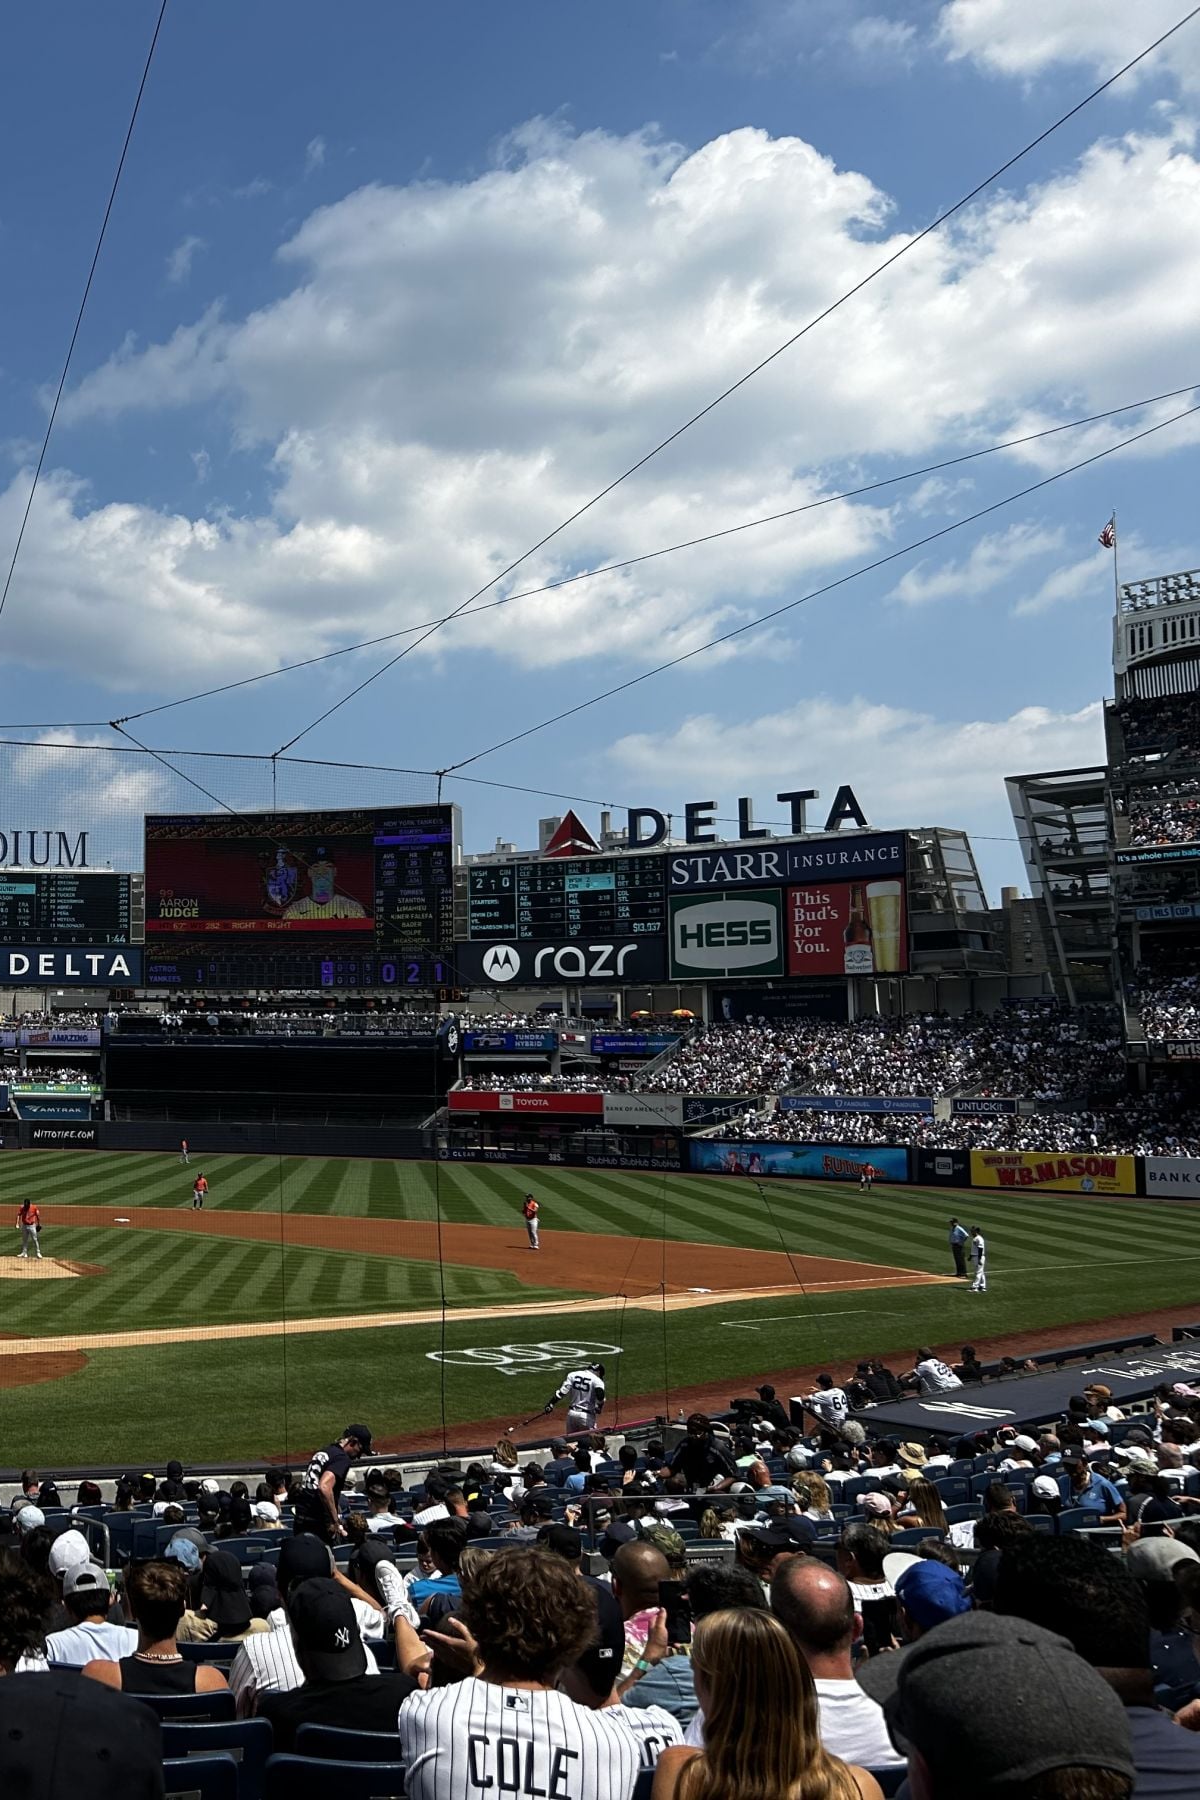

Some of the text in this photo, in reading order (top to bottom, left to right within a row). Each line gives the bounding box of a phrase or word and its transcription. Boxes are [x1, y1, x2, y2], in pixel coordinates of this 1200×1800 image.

[628, 785, 868, 848] DELTA
[1117, 850, 1181, 863] It's whole new
[671, 851, 784, 886] STARR
[793, 846, 899, 869] INSURANCE
[476, 877, 510, 888] 2 0
[159, 898, 198, 908] AARON
[792, 891, 830, 905] This
[159, 908, 200, 918] JUDGE
[793, 905, 839, 922] Bud's
[680, 919, 772, 949] HESS
[793, 923, 822, 938] For
[105, 934, 126, 943] 1:44
[794, 939, 830, 954] You.
[9, 953, 131, 976] DELTA
[535, 943, 638, 978] razr
[148, 964, 177, 973] ASTROS
[382, 963, 444, 983] 0 2 1
[148, 975, 182, 983] YANKEES
[515, 1040, 542, 1048] HYBRID
[957, 1102, 1003, 1112] UNTUCKit
[33, 1128, 94, 1140] NITTOTIRE.COM
[452, 1150, 476, 1158] CLEAR
[484, 1151, 508, 1159] STARR
[586, 1156, 618, 1165] StubHub
[619, 1157, 649, 1167] StubHub
[651, 1158, 681, 1168] StubHub
[983, 1155, 1023, 1165] WHO BUT
[1149, 1171, 1191, 1182] BANK
[572, 1376, 591, 1392] 25
[830, 1394, 849, 1411] 64
[469, 1734, 579, 1800] COLE
